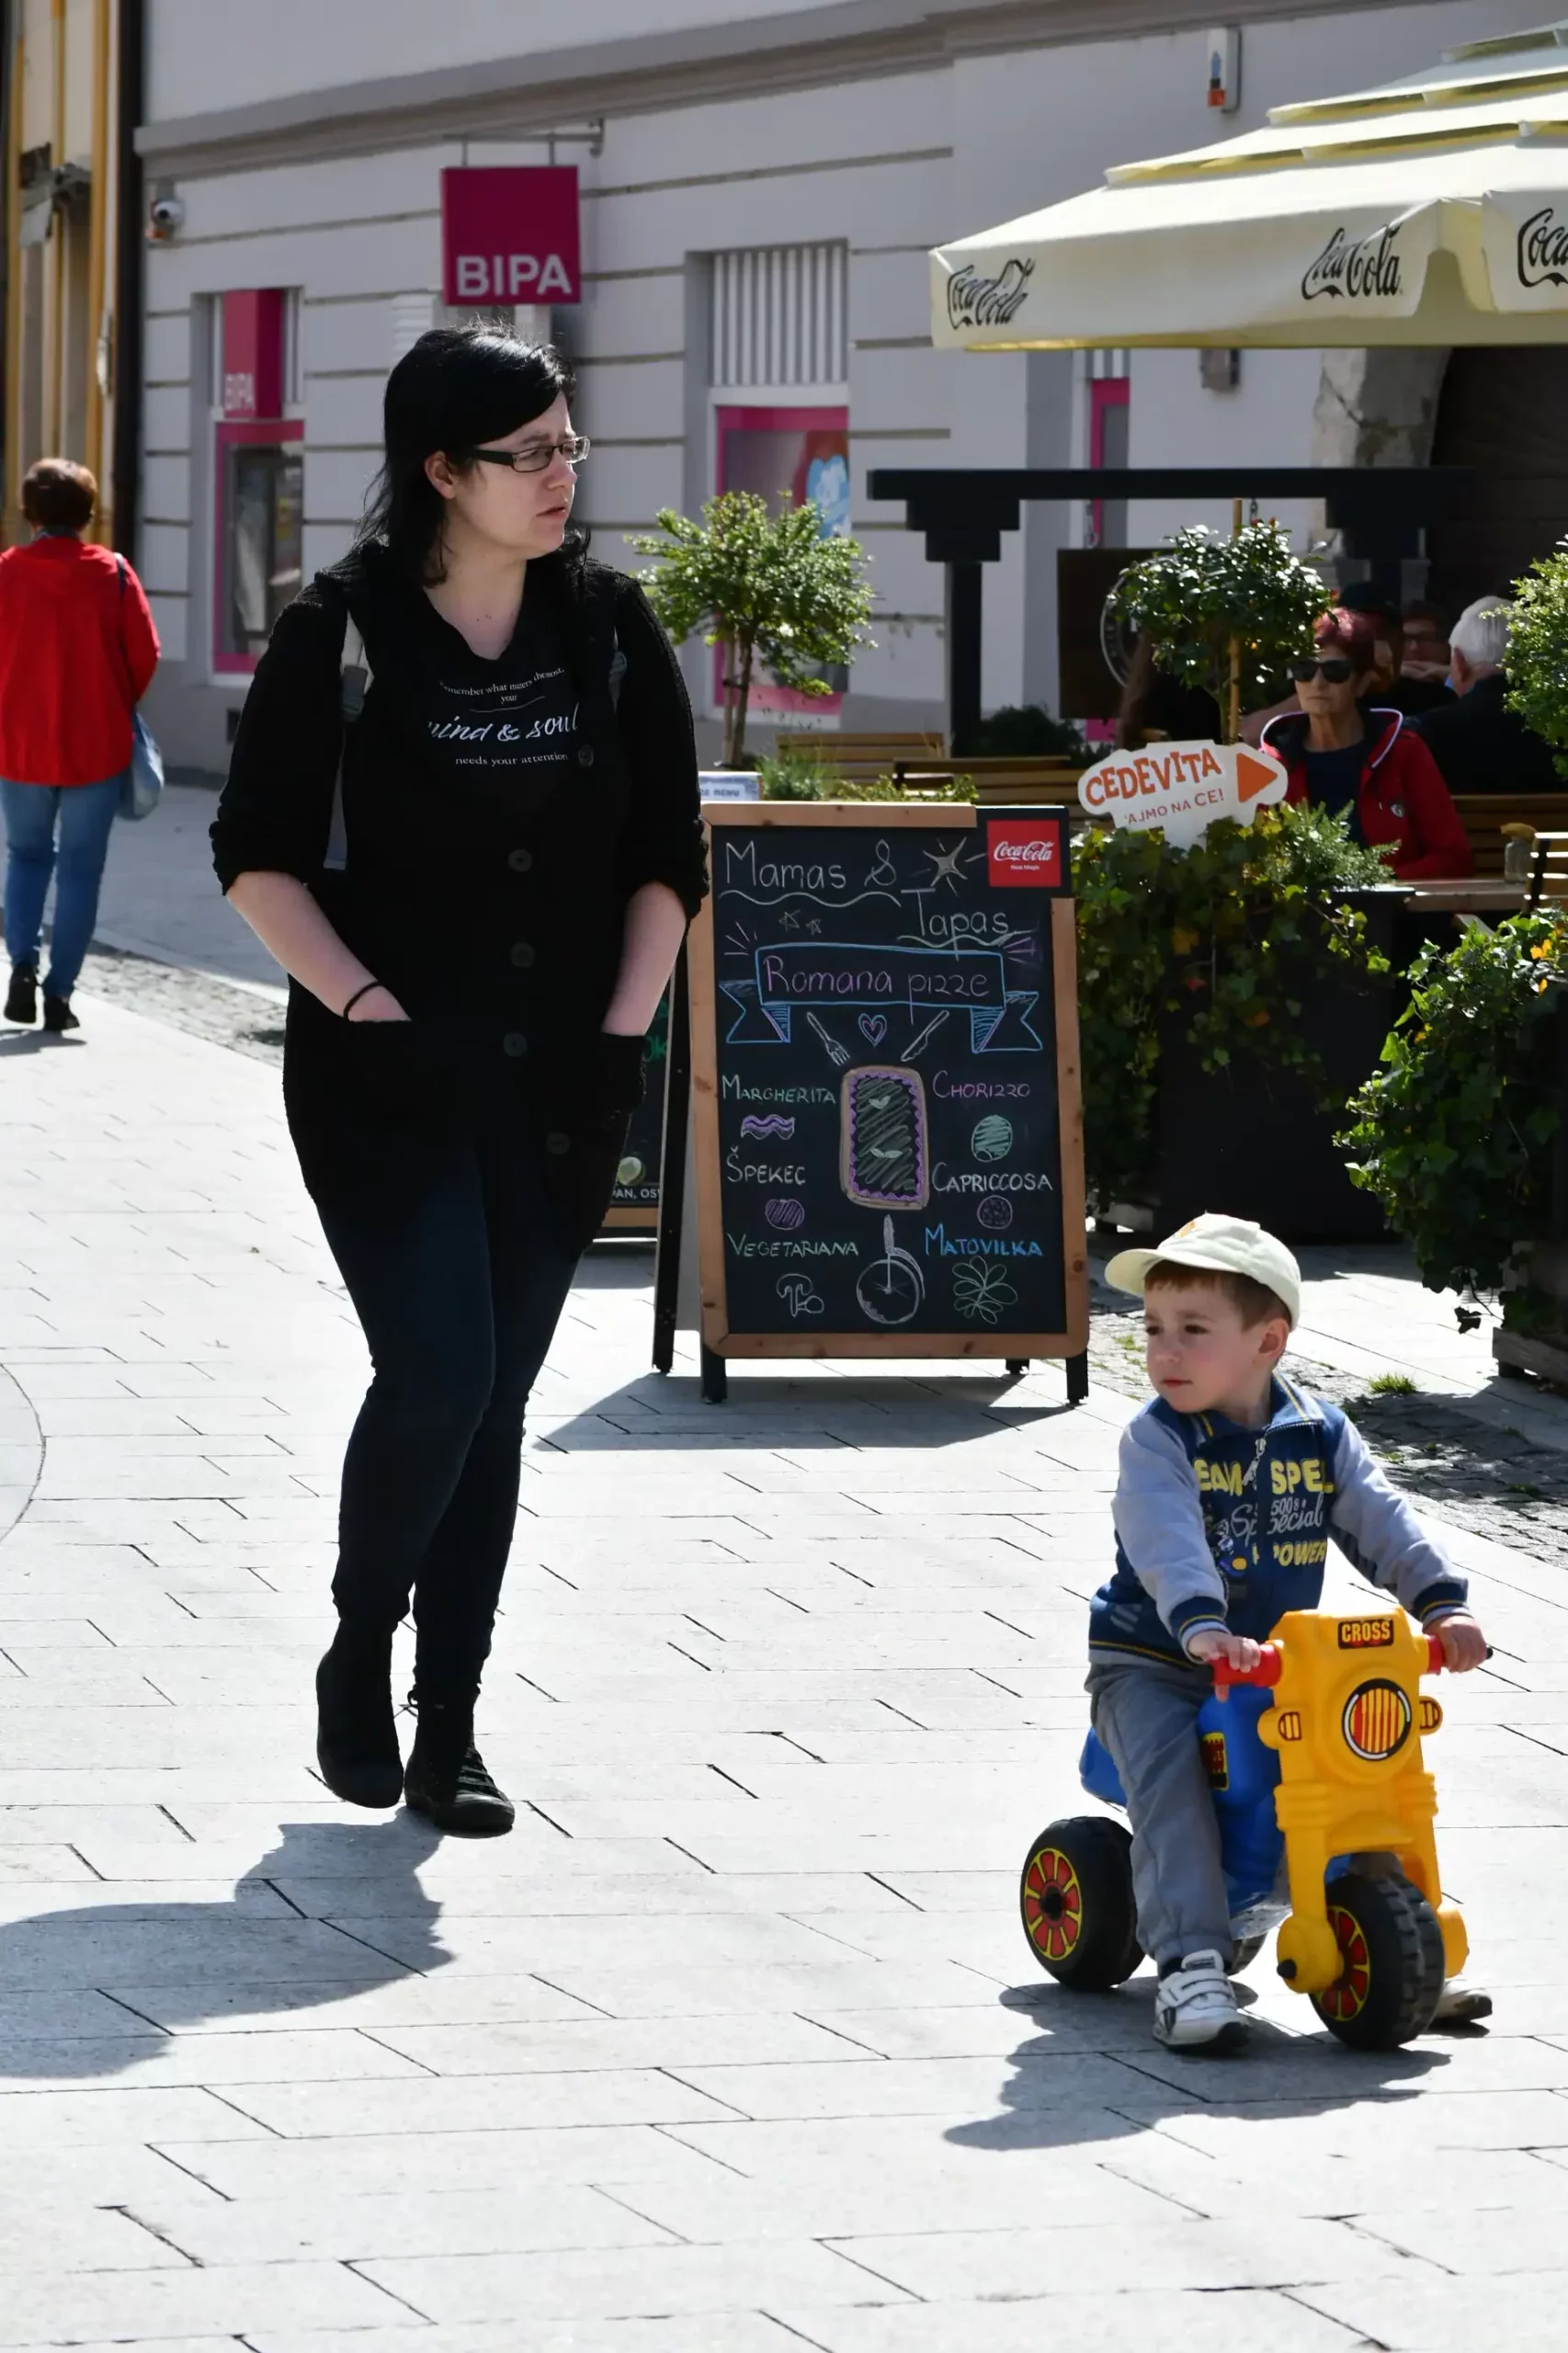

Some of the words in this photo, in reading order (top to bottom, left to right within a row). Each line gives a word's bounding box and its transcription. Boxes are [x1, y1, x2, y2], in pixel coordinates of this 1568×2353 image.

[457, 255, 572, 297] BIPA
[224, 372, 255, 411] BIPA
[485, 683, 507, 694] what
[500, 694, 517, 705] your
[497, 723, 520, 742] &
[526, 702, 579, 739] soul
[455, 756, 488, 766] needs
[491, 757, 517, 767] your
[521, 752, 569, 764] attention
[1085, 748, 1222, 806] CEDEVITA
[1171, 800, 1191, 813] NA
[1194, 788, 1224, 807] CE!
[725, 839, 846, 890] Mamas
[863, 838, 896, 887] &
[994, 840, 1055, 861] Coca-Cola
[901, 887, 1010, 961] Tapas
[763, 954, 892, 994] Romana
[1341, 1620, 1392, 1643] CROSS
